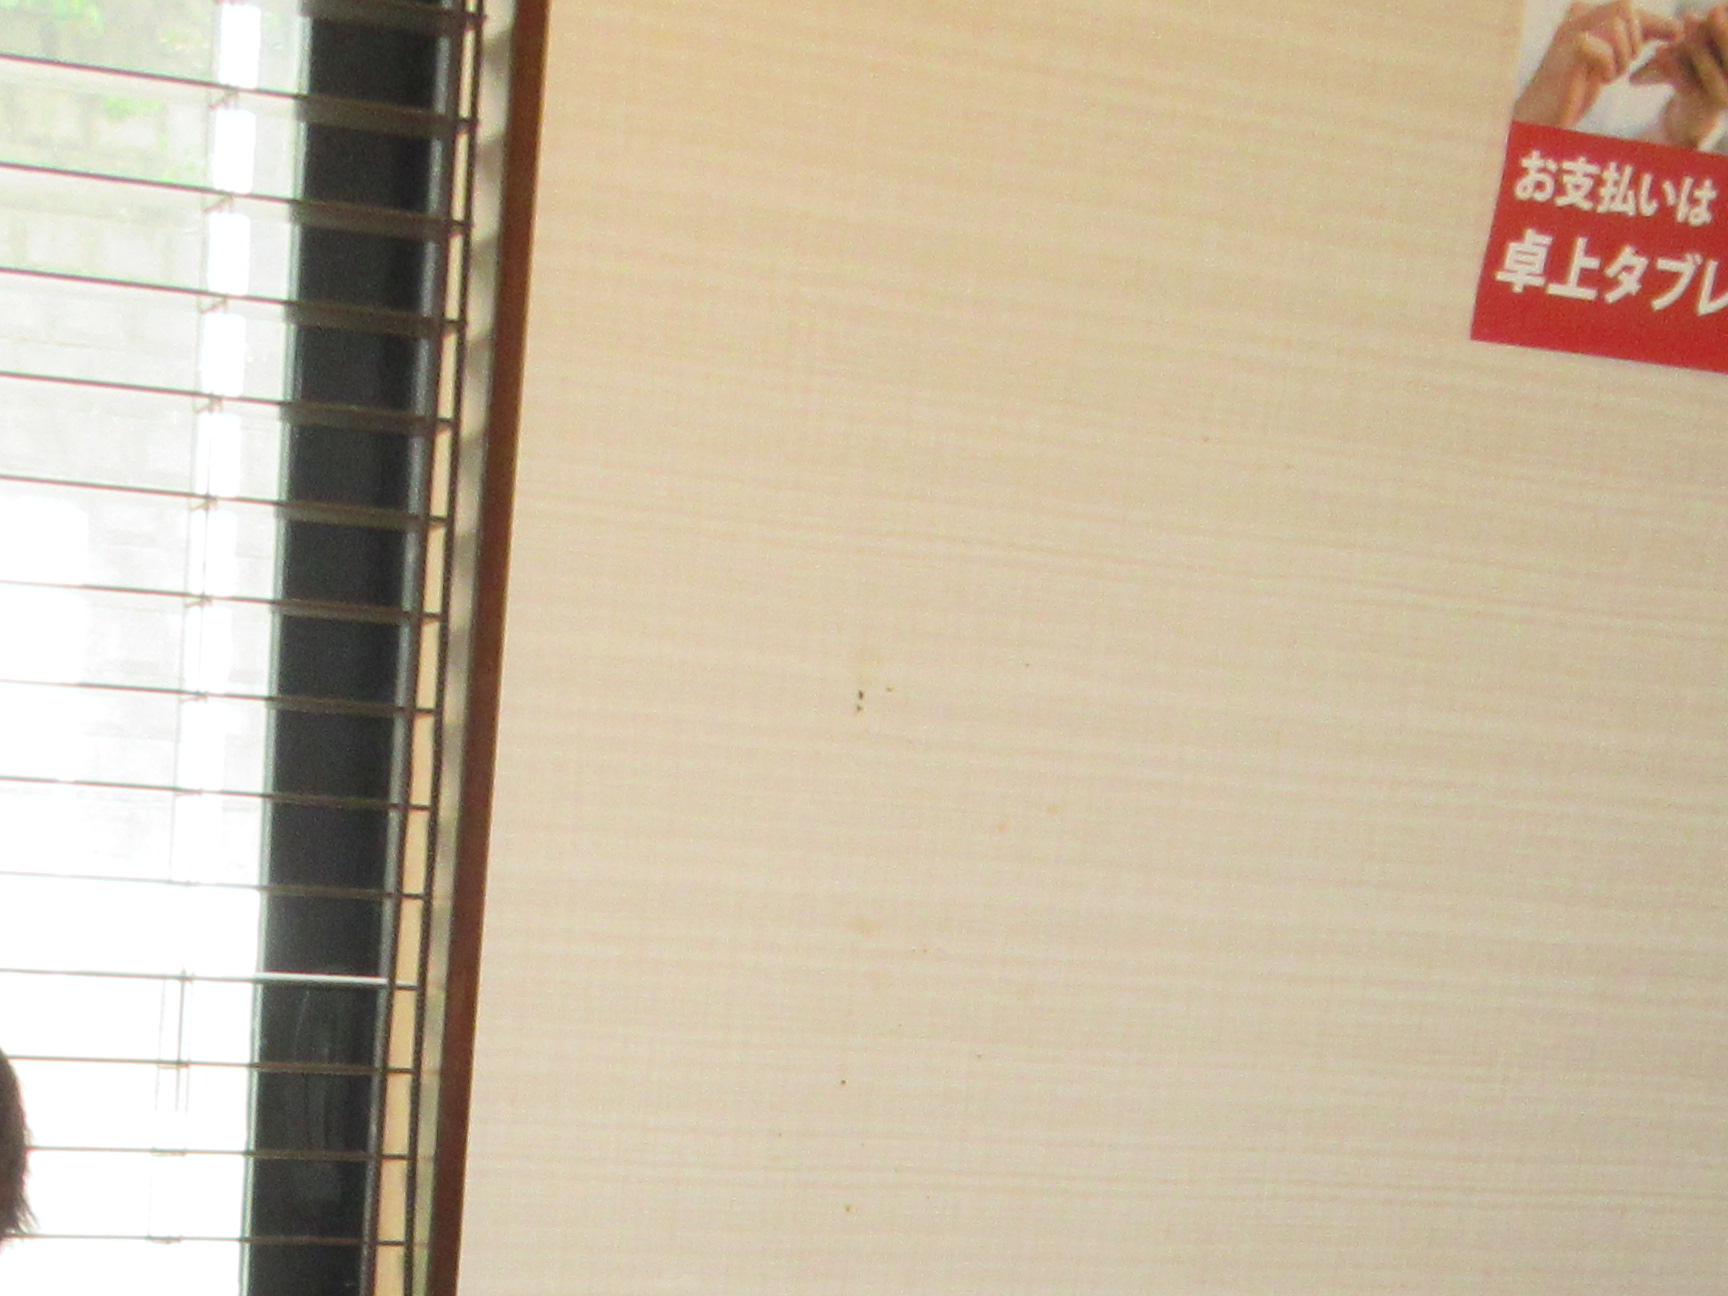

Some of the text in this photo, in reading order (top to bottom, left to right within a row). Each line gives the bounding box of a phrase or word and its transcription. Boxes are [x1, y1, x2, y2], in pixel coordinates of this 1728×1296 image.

[1514, 149, 1719, 227] お支払いは
